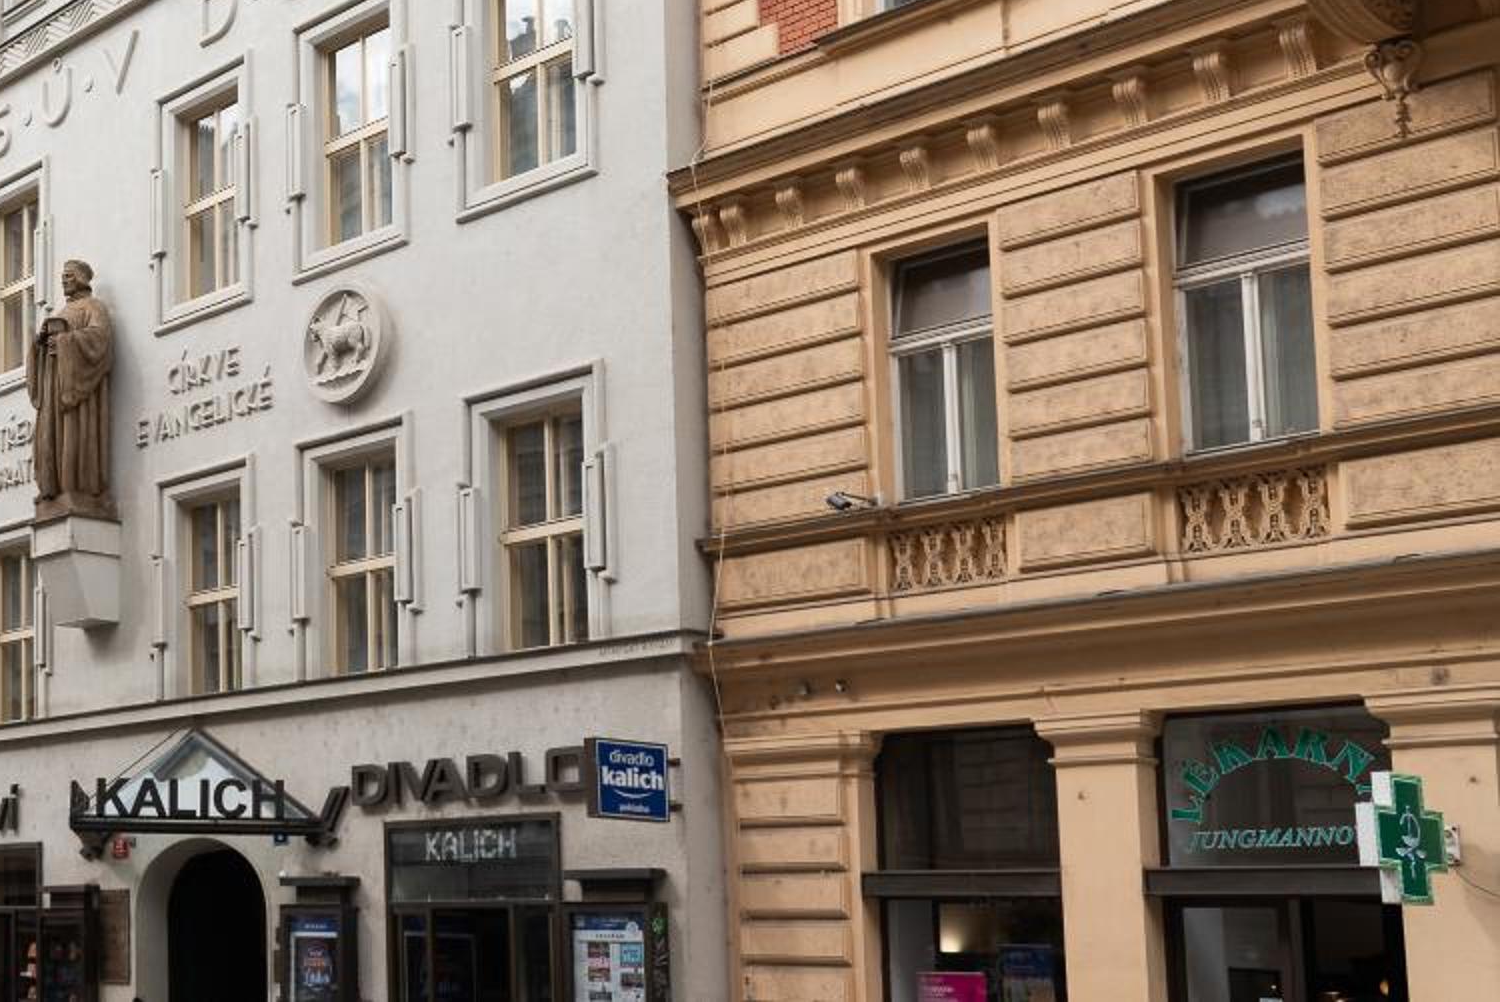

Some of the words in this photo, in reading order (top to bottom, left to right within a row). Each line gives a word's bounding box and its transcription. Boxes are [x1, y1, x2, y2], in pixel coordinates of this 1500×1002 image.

[134, 364, 275, 450] EVANGELICKÉ
[609, 749, 655, 768] divadlo
[351, 746, 585, 810] DIVADLO
[601, 765, 664, 791] kalich
[96, 777, 285, 821] KALICH
[425, 827, 518, 863] KALICH
[1188, 824, 1357, 853] JUNGMANNO
